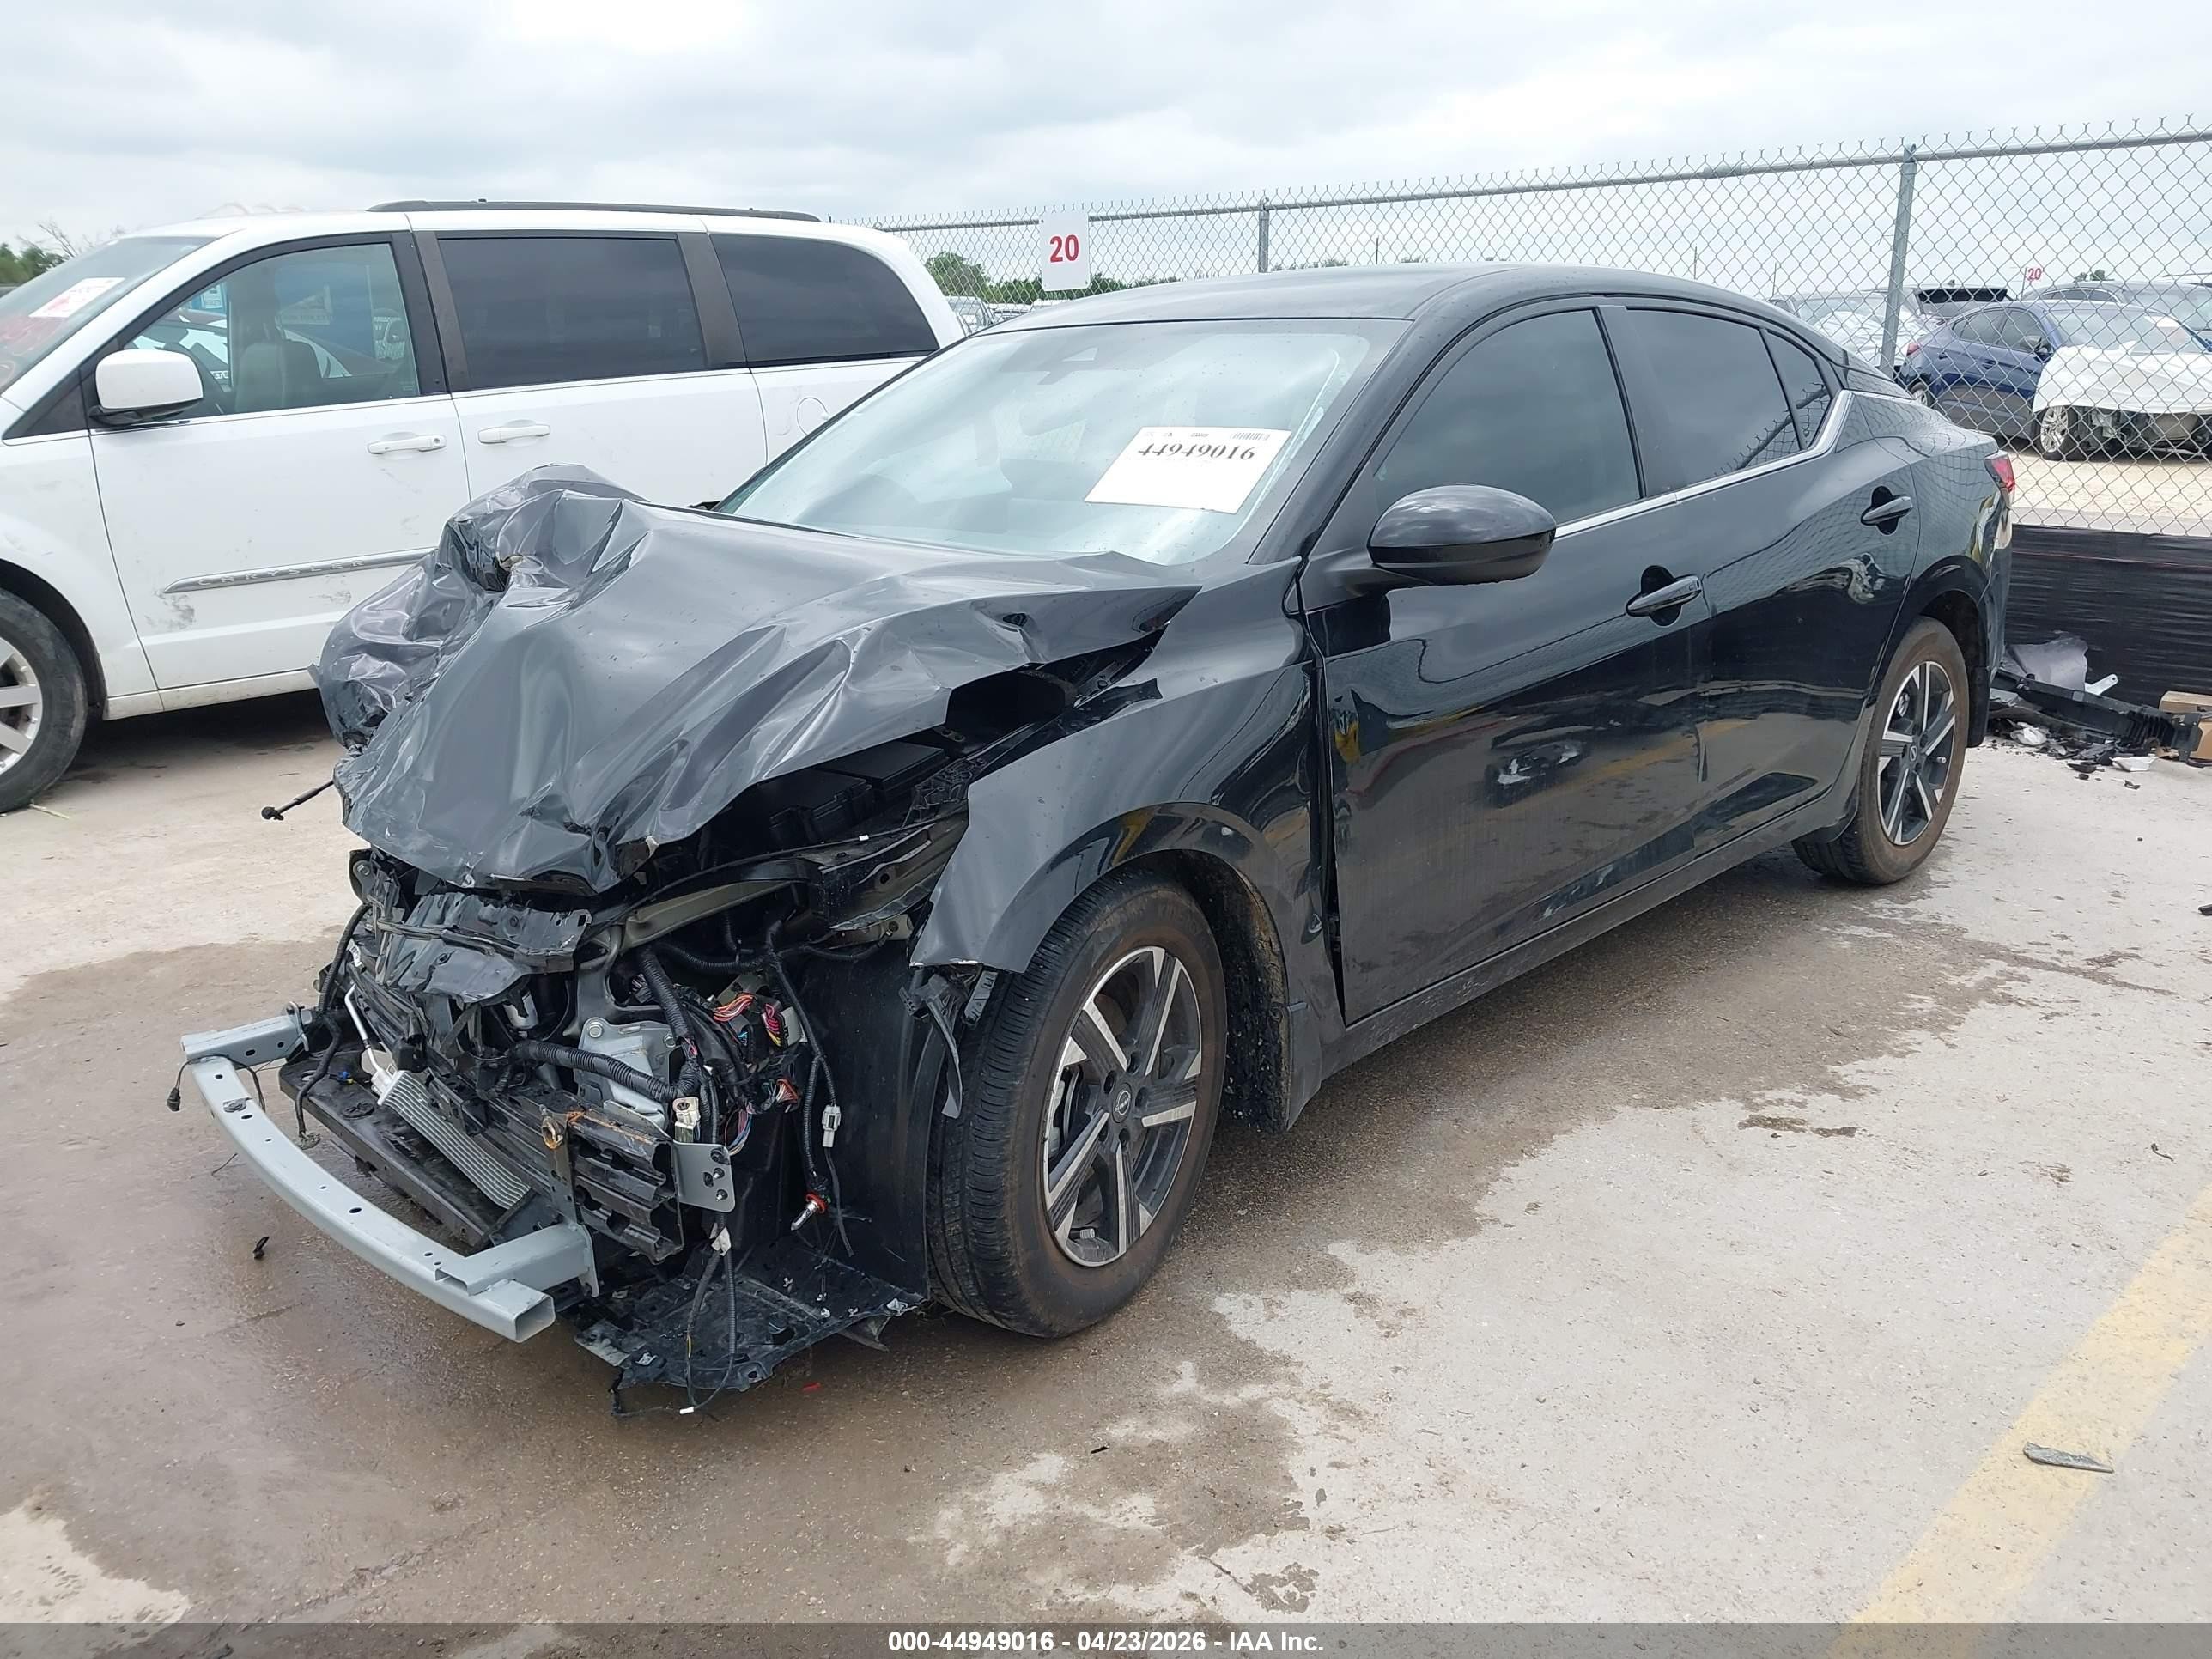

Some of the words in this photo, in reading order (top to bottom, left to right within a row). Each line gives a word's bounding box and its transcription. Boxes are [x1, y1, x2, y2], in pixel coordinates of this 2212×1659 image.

[1049, 234, 1079, 263] 20
[2027, 268, 2042, 280] 20
[1138, 443, 1258, 460] 44949016
[198, 559, 364, 586] CHRYSLER
